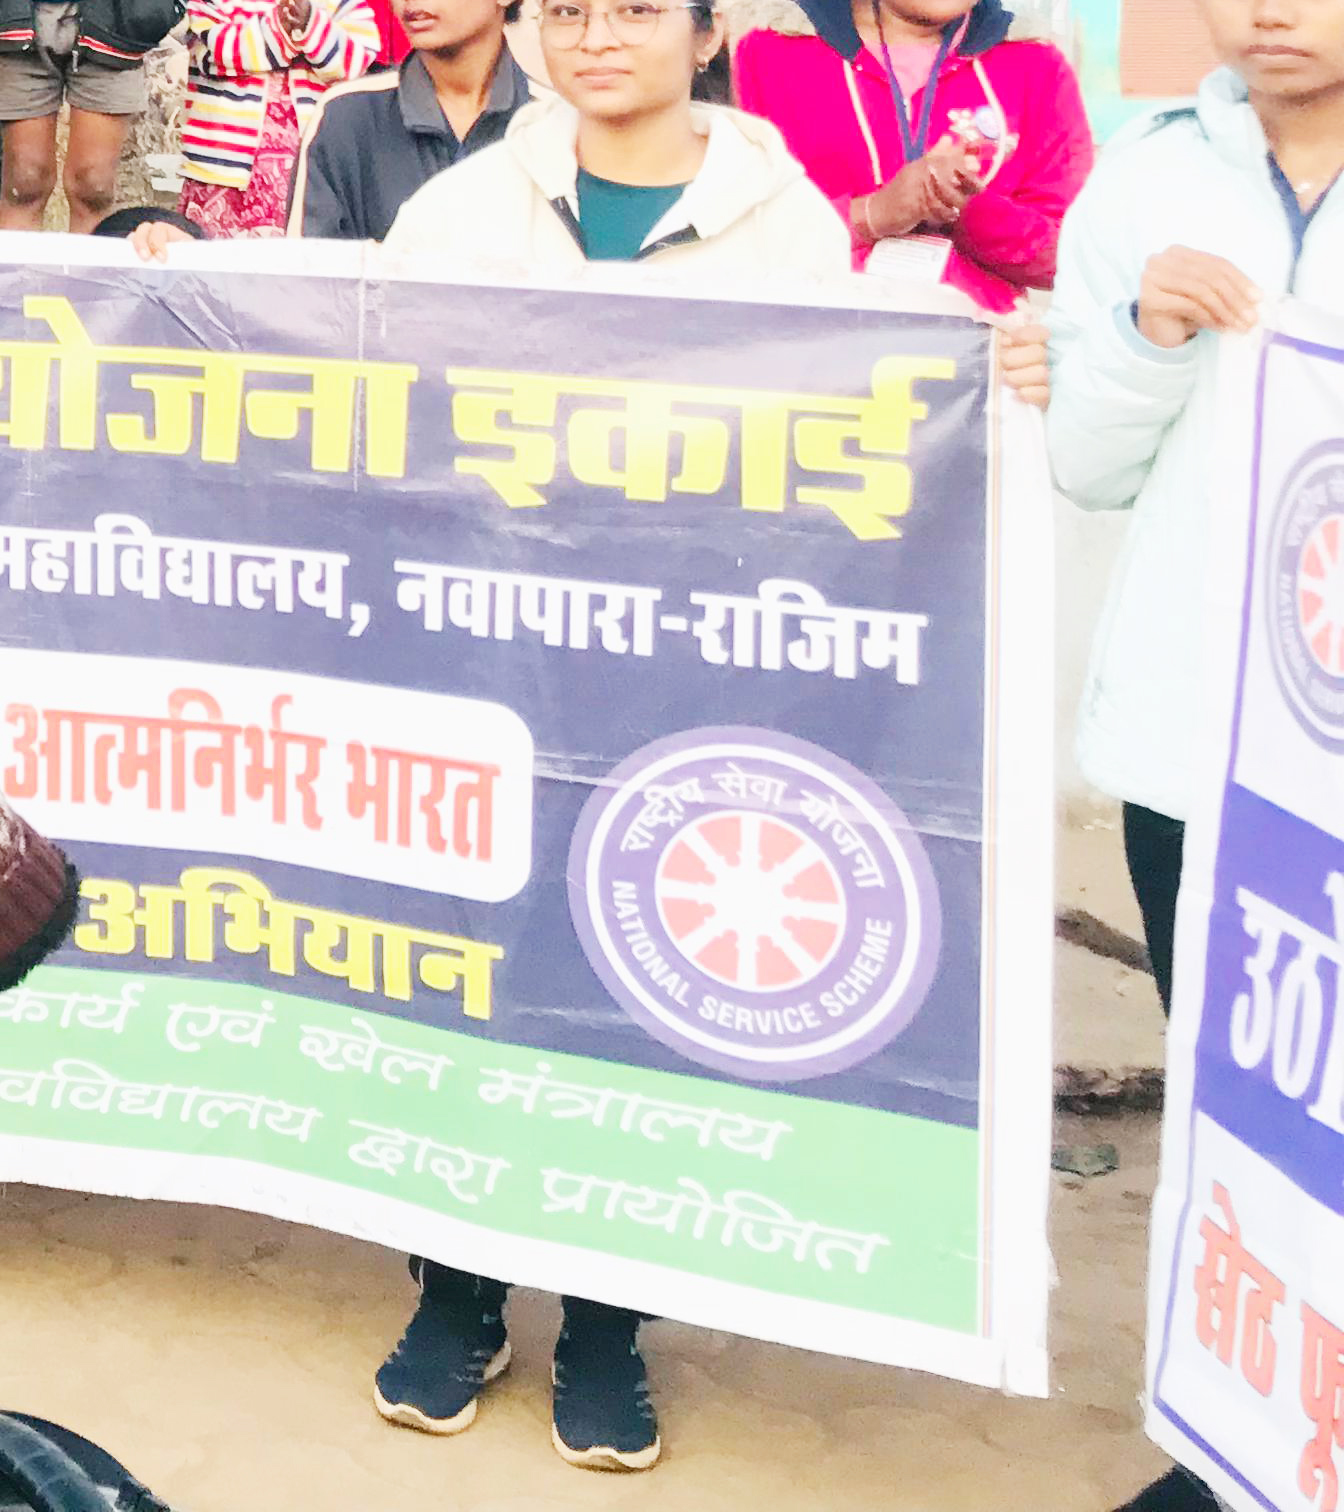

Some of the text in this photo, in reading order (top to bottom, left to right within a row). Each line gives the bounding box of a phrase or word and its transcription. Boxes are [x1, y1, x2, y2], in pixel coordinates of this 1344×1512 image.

[446, 356, 956, 541] इकाई
[393, 560, 928, 686] नवापारा-राजिम
[3, 687, 501, 862] आत्मनिर्भर भारत
[620, 761, 886, 888] राष्ट्रीय सेवा योजना
[74, 867, 504, 1020] अभियान
[612, 880, 893, 1035] NATIONAL SERVICE SCHEME
[166, 1000, 275, 1052] एवं
[300, 1018, 454, 1092] खेल
[478, 1062, 793, 1161] मंत्रालय
[348, 1120, 511, 1203] द्वारा
[540, 1177, 891, 1274] प्रायोजित
[1193, 1179, 1286, 1398] सेठ
